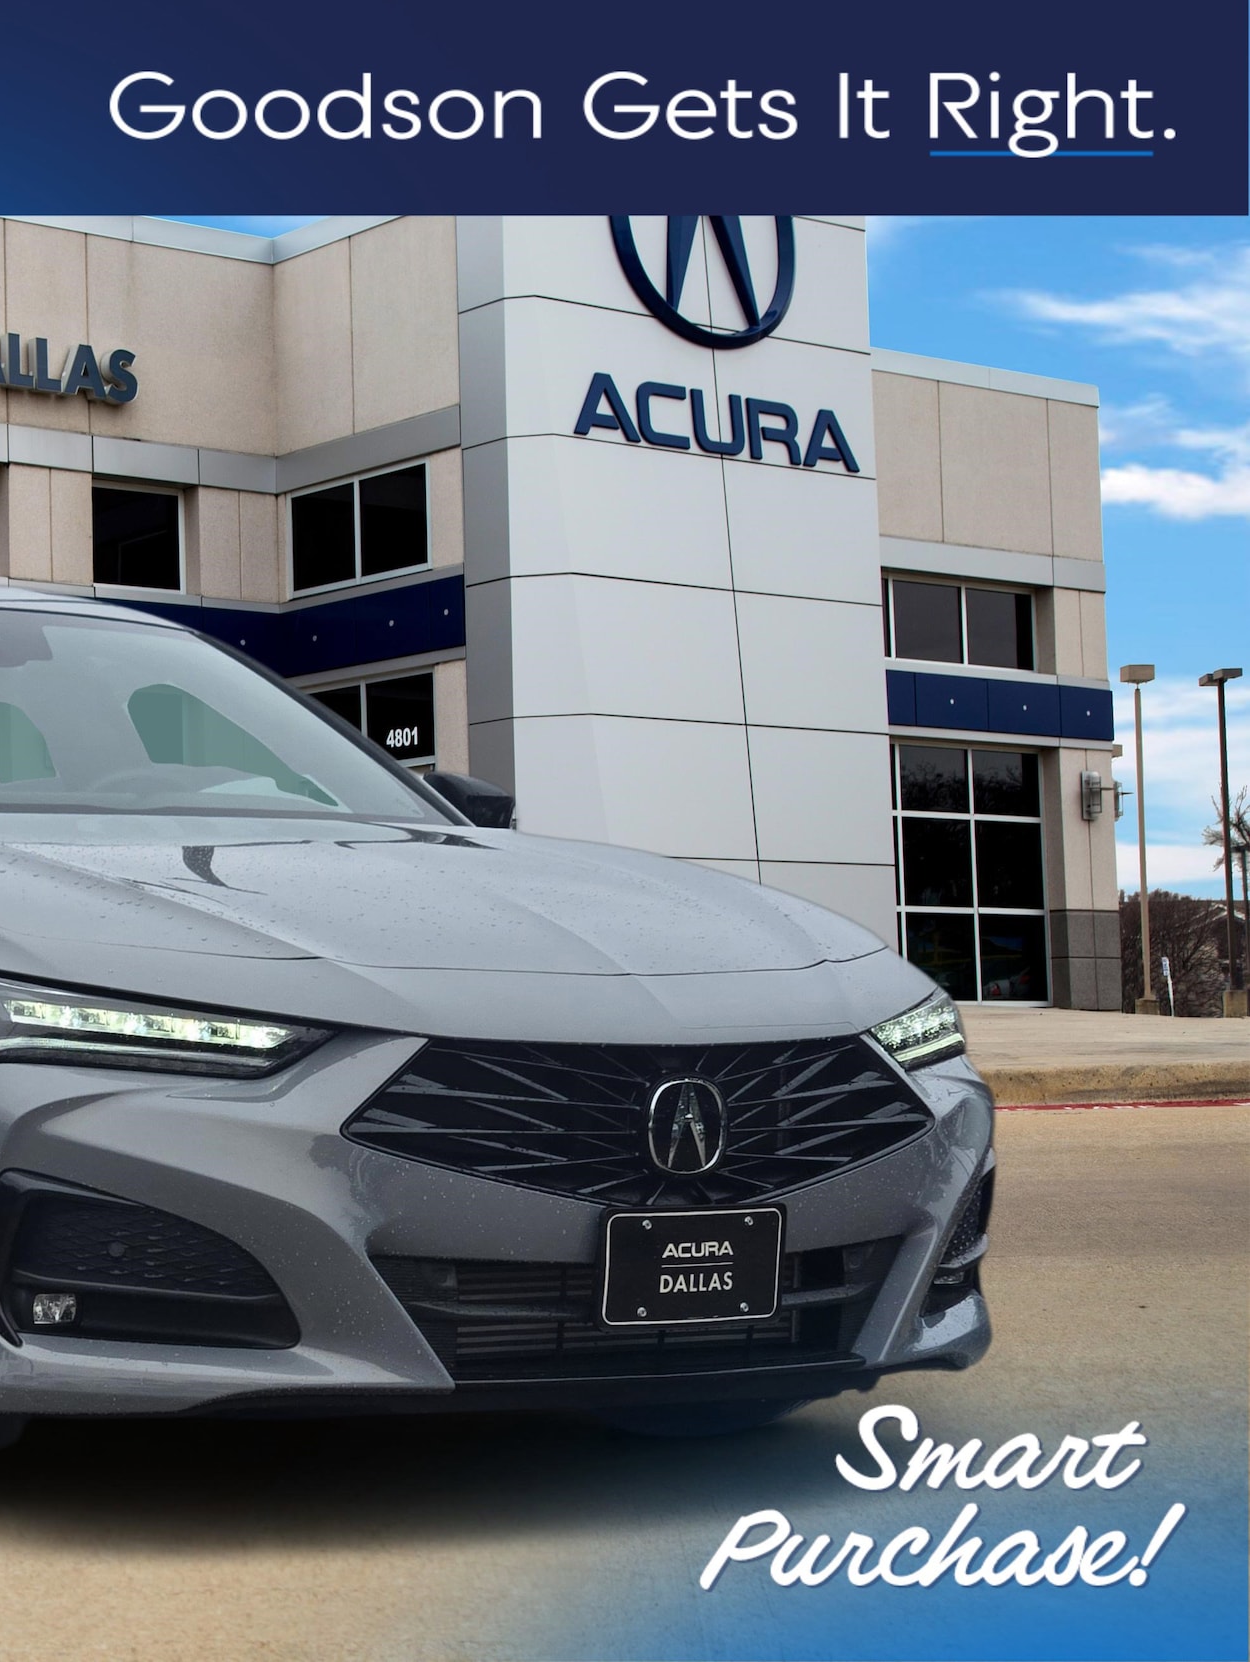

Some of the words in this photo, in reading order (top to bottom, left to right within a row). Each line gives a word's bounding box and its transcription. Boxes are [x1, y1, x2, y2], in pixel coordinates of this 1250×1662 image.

[574, 372, 860, 474] ACURA
[386, 726, 418, 748] 4801
[661, 1240, 734, 1259] ACURA
[659, 1271, 733, 1294] DALLAS
